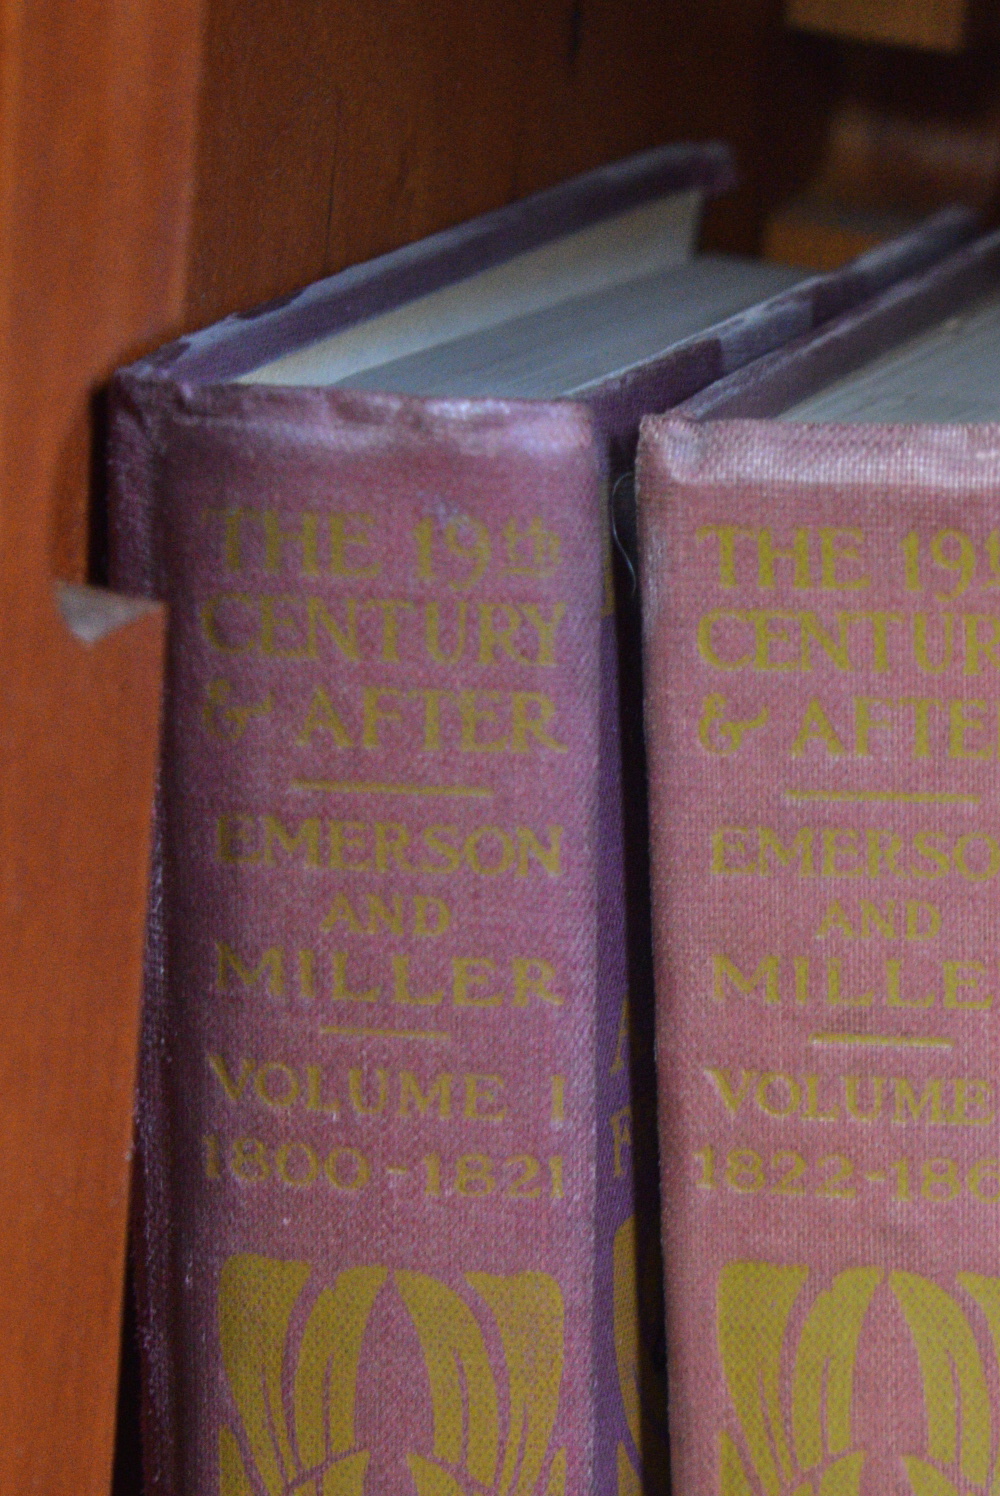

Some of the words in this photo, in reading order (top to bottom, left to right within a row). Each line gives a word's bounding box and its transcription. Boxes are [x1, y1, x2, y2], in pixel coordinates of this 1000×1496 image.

[201, 507, 381, 579] THE
[413, 514, 562, 591] 19th
[697, 525, 871, 591] THE
[202, 594, 567, 667] CENTURY
[203, 678, 271, 741] &
[298, 685, 569, 754] AFTER
[699, 693, 769, 757] &
[215, 814, 564, 878] EMERSON
[319, 894, 451, 937] AND
[815, 899, 942, 941] AND
[215, 942, 565, 1008] MILLER
[208, 1054, 506, 1122] VOLUME
[549, 1074, 566, 1122] I
[704, 1068, 996, 1126] VOLUME
